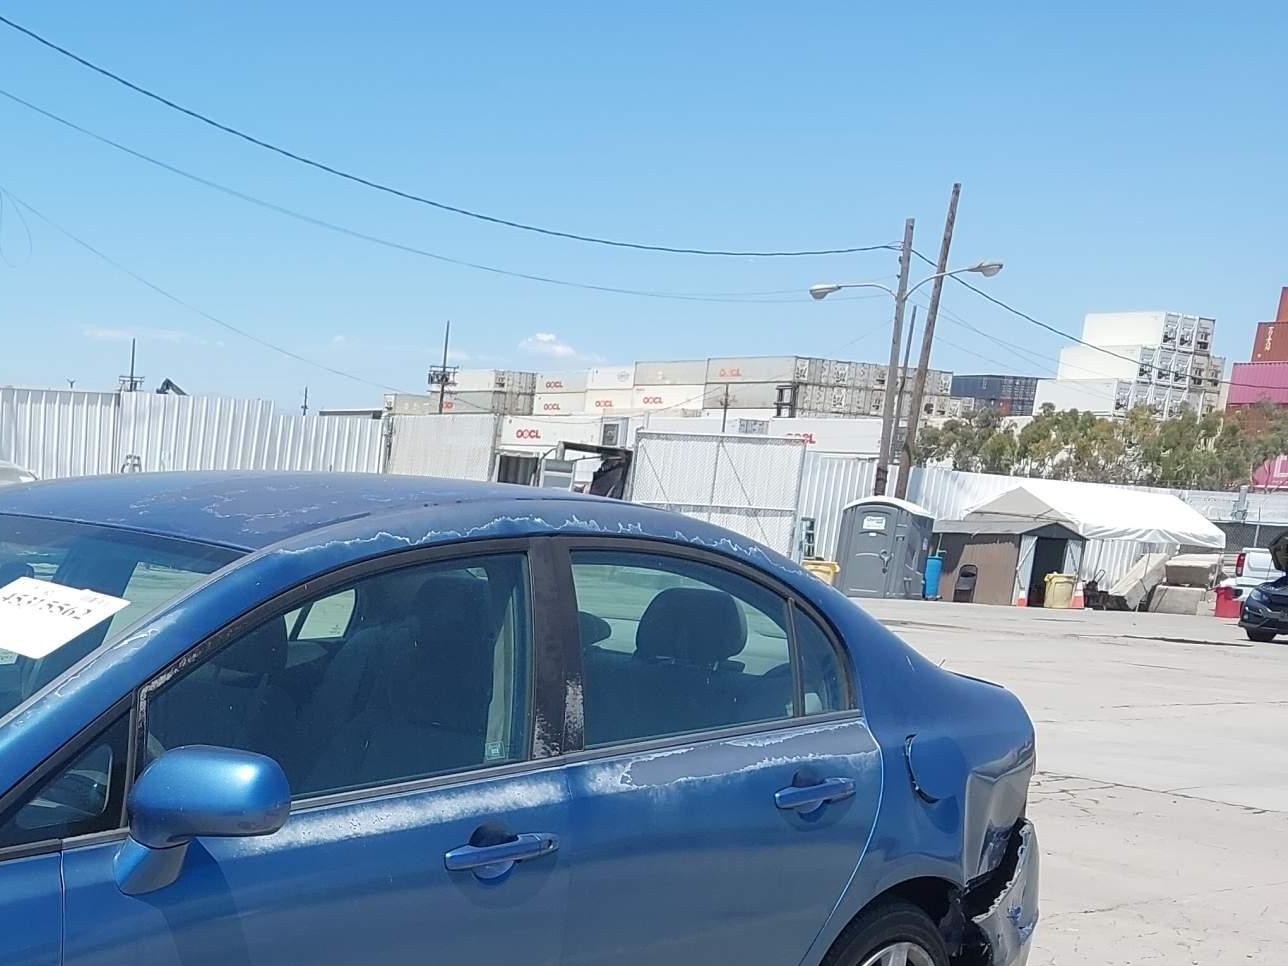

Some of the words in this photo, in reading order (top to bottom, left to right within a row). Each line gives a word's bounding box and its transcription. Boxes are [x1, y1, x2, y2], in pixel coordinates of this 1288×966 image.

[545, 380, 564, 389] OOCL
[594, 399, 615, 408] OOCL
[642, 396, 664, 404] OOCL
[543, 402, 561, 411] OOCL
[515, 428, 541, 439] OOCL
